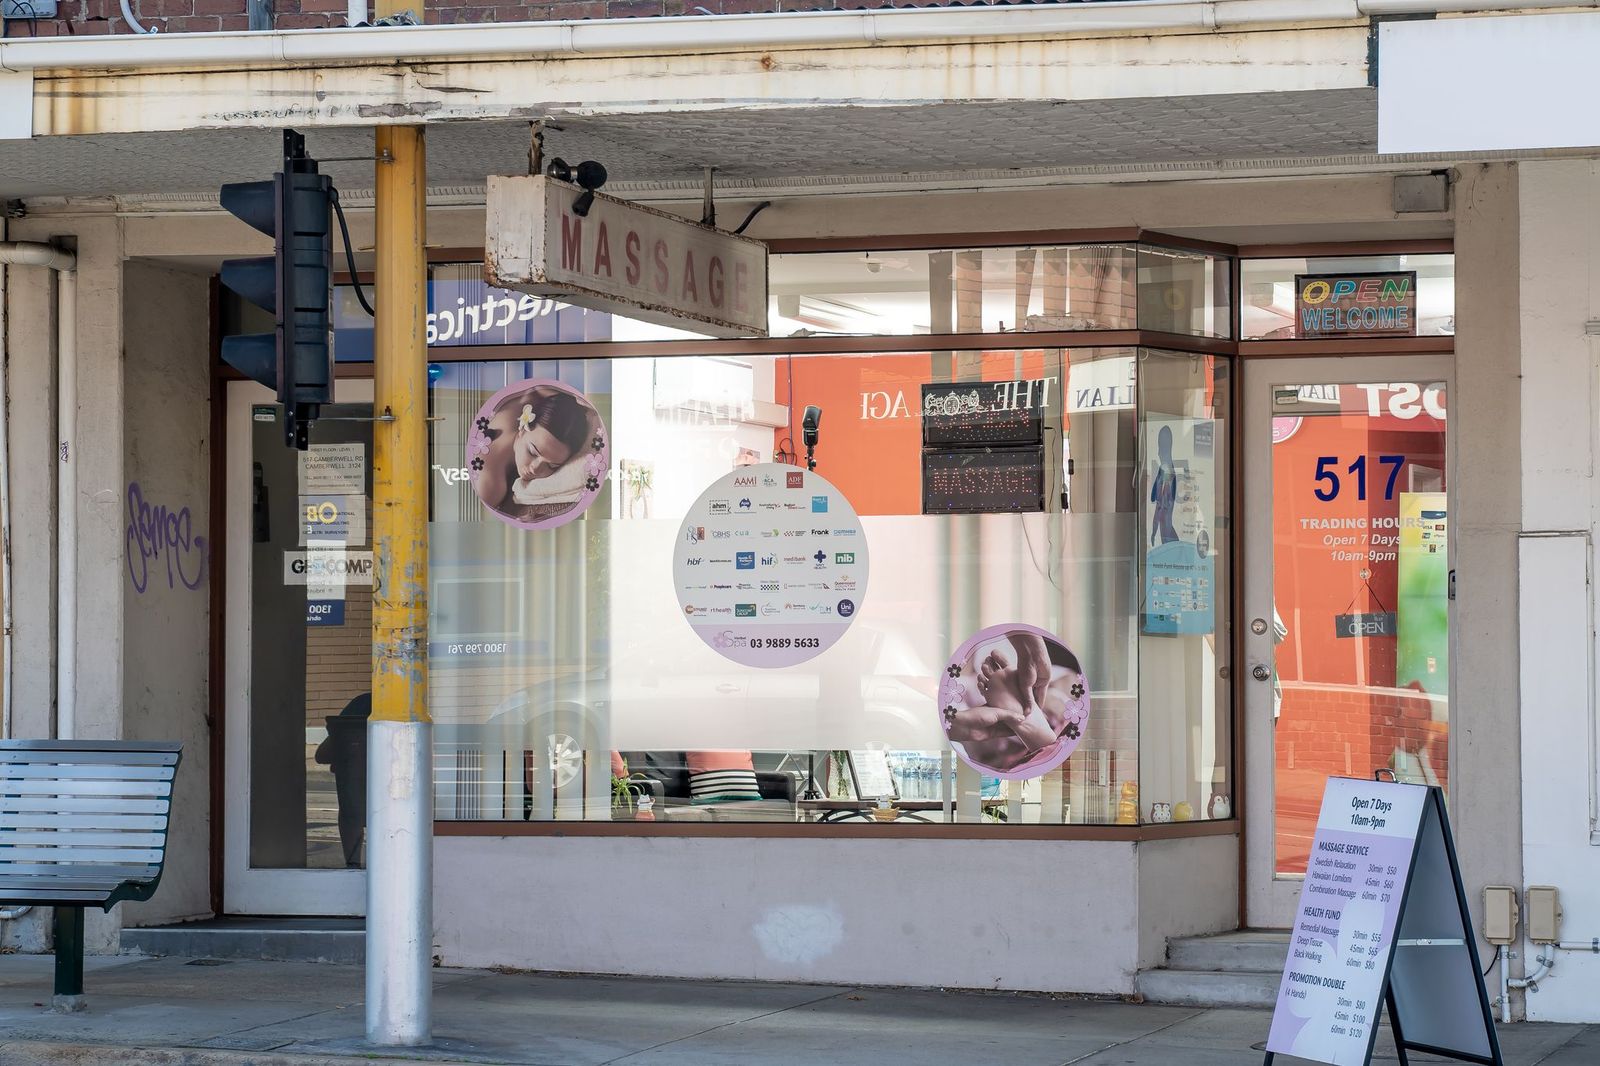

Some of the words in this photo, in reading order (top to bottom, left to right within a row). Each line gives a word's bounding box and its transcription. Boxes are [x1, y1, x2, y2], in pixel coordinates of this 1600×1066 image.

[561, 214, 748, 312] MASSAGE
[1302, 279, 1409, 304] OPEN
[1302, 305, 1409, 330] WELCOME
[734, 476, 757, 486] AAMI
[934, 466, 1033, 495] MASSAGE
[1314, 455, 1405, 502] 517
[1300, 518, 1368, 529] TRADING
[1372, 517, 1425, 529] HOURS
[1323, 535, 1357, 548] Open
[1361, 535, 1368, 545] 7
[1371, 534, 1400, 547] Days
[837, 553, 855, 564] nib
[1331, 550, 1397, 563] 10am-9pm
[1348, 622, 1385, 635] OPEN
[750, 638, 763, 648] 03
[766, 638, 792, 648] 9889
[794, 637, 820, 648] 5633
[1351, 796, 1369, 811] Open
[1370, 798, 1376, 809] 7
[1375, 798, 1392, 813] Days
[1351, 814, 1386, 830] 10am-9pm
[1318, 841, 1346, 853] MASSAGE
[1345, 844, 1369, 856] SERVICE
[1315, 857, 1334, 868] Swedish
[1333, 859, 1357, 870] Relaxation
[1368, 863, 1384, 873] 30min
[1386, 865, 1398, 875] $50
[1365, 877, 1380, 887] 45min
[1383, 879, 1395, 889] $60
[1308, 884, 1337, 896] Combination
[1337, 887, 1357, 900] Massage
[1361, 891, 1377, 901] 60min
[1303, 906, 1325, 918] HEALTH
[1324, 909, 1341, 921] FUND
[1300, 922, 1321, 933] Remedial
[1320, 925, 1340, 938] Massage
[1352, 930, 1368, 940] 30min
[1296, 935, 1309, 946] Deep
[1309, 937, 1323, 948] Tissue
[1349, 944, 1365, 953] 45min
[1293, 949, 1305, 958] Back
[1304, 950, 1322, 964] Walking
[1346, 957, 1361, 968] 60min
[1288, 971, 1323, 986] PROMOTION
[1322, 977, 1346, 990] DOUBLE
[1290, 988, 1307, 999] Hands)
[1336, 996, 1353, 1007] 30min
[1334, 1011, 1349, 1021] 45min
[1352, 1013, 1366, 1025] $100
[1330, 1024, 1346, 1035] 60min
[1348, 1027, 1363, 1039] $120
